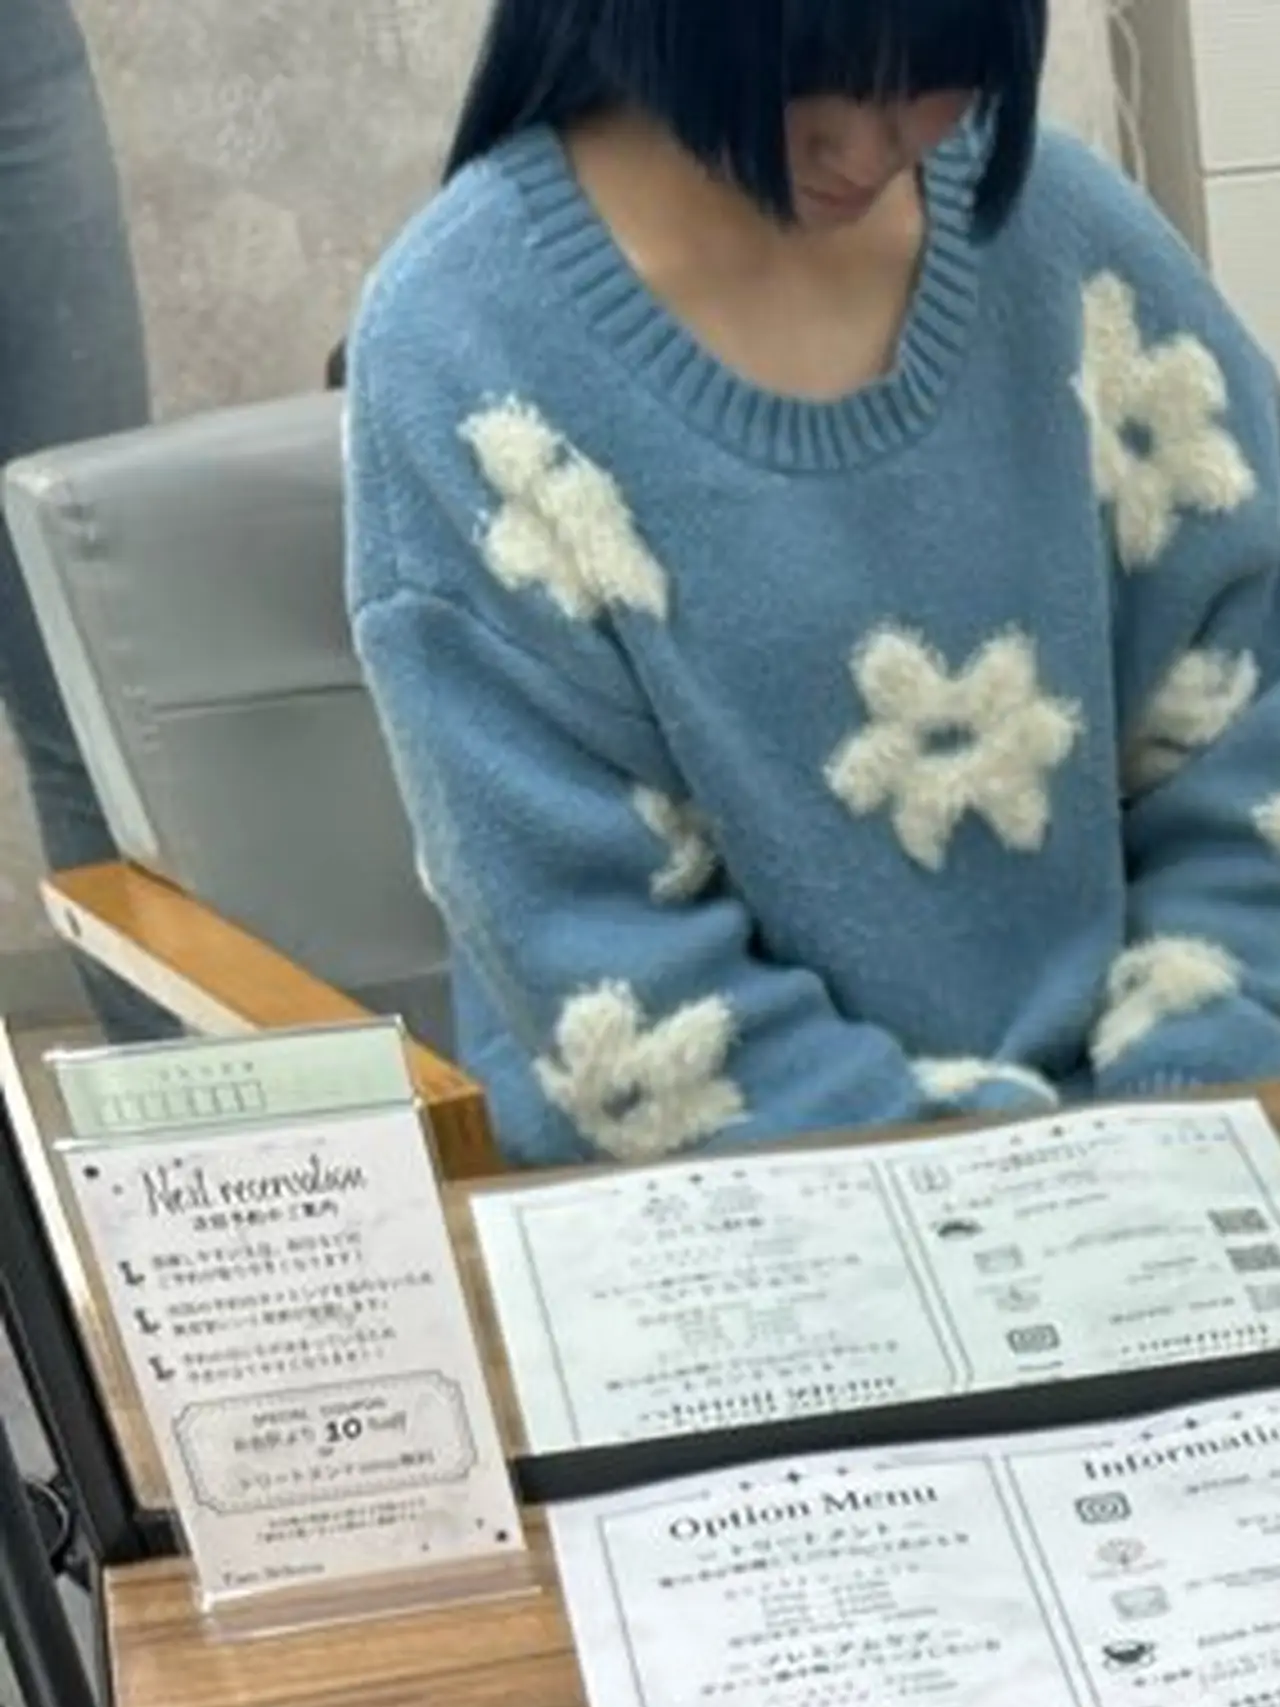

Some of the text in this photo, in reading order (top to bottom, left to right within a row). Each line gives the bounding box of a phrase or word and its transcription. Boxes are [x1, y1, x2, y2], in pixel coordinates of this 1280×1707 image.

[219, 1153, 366, 1200] reservation
[324, 1417, 363, 1443] 10
[668, 1483, 939, 1541] Option Menu
